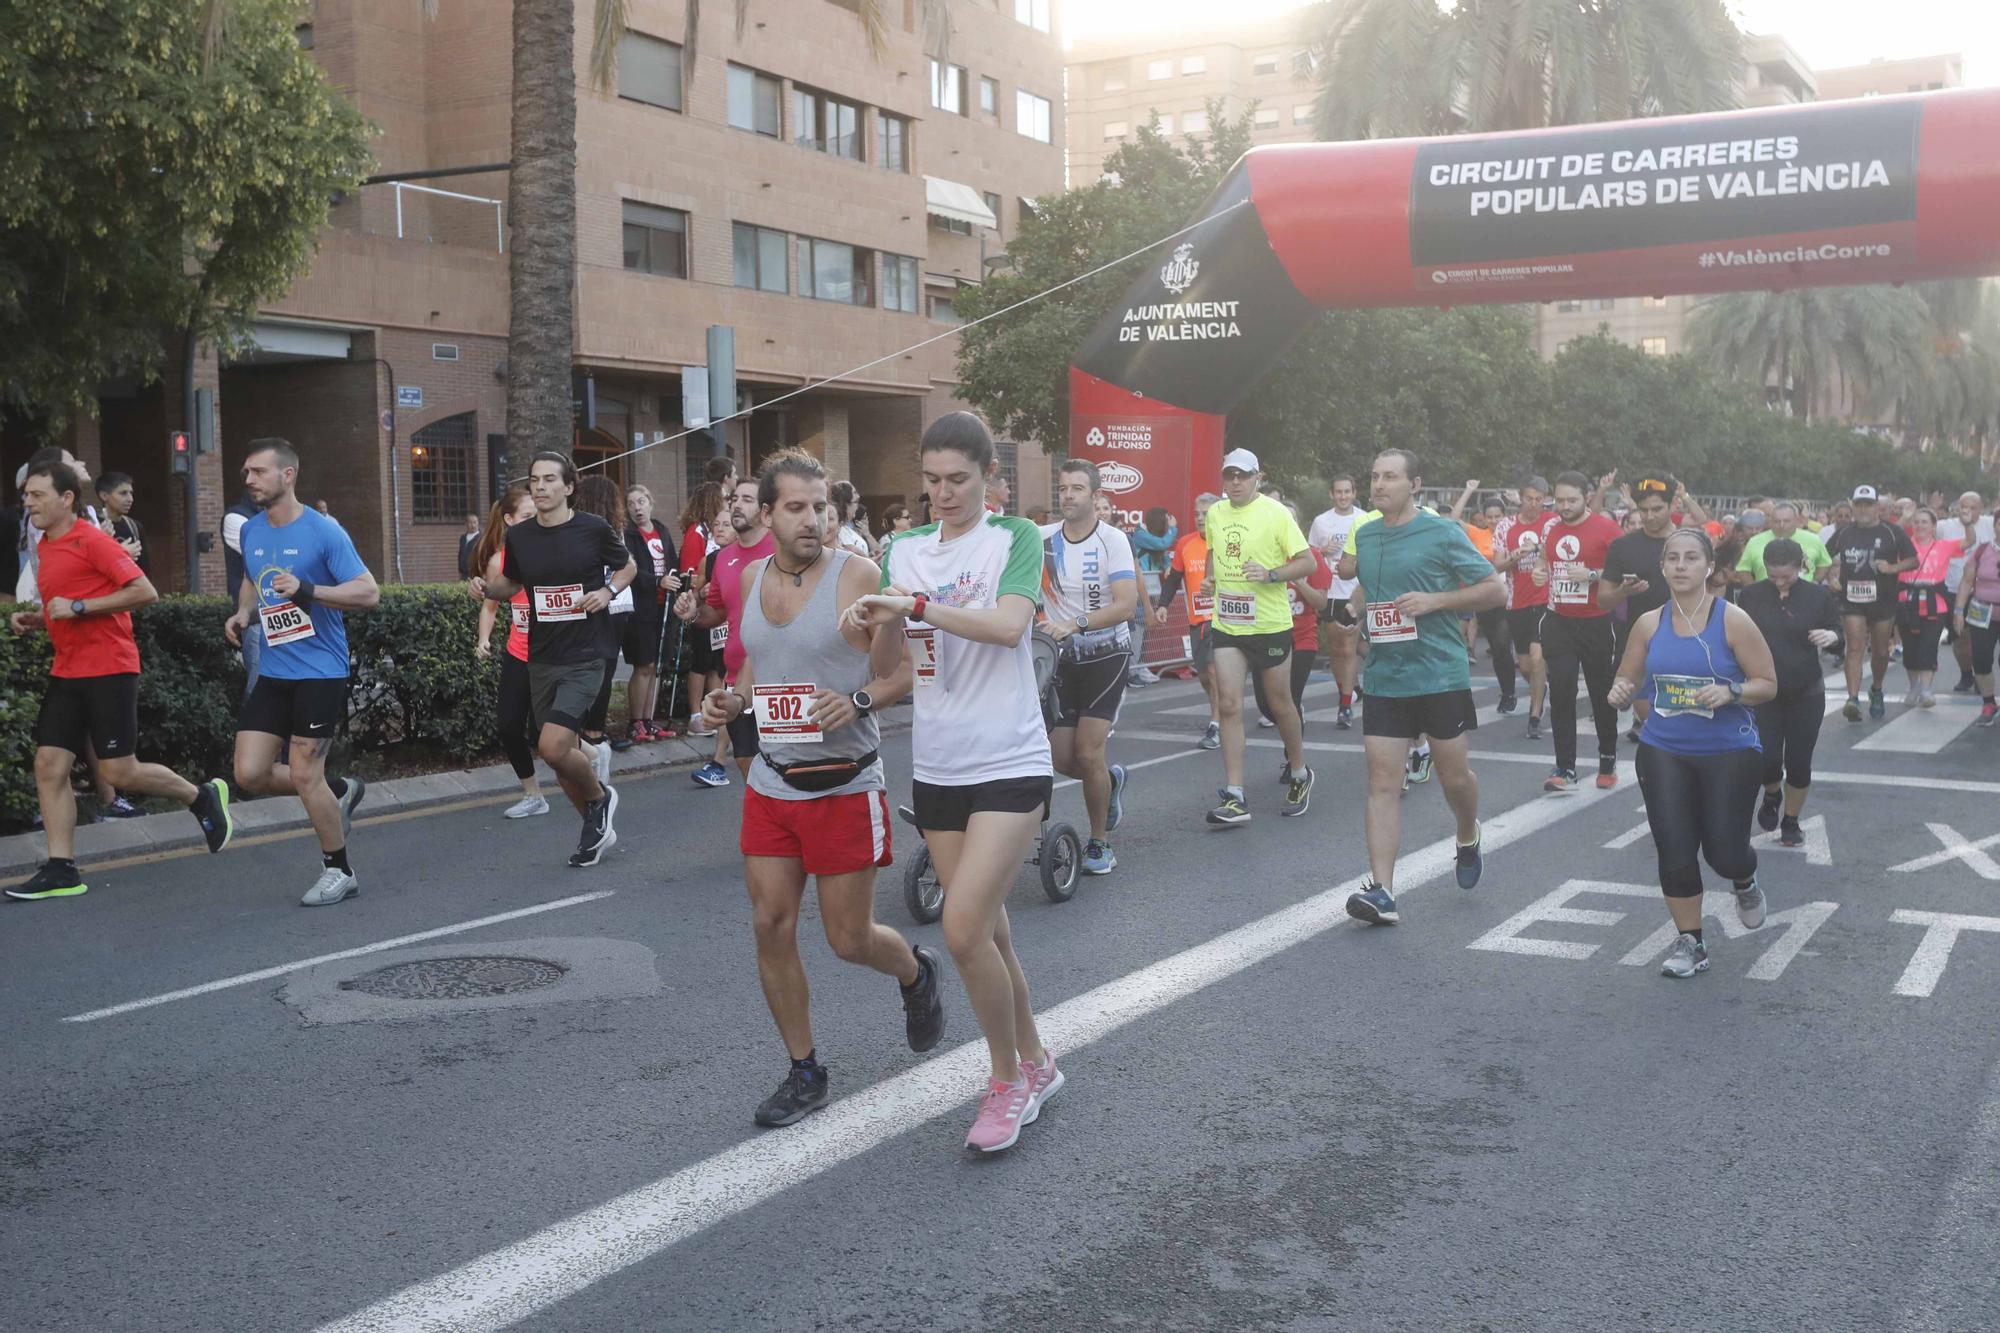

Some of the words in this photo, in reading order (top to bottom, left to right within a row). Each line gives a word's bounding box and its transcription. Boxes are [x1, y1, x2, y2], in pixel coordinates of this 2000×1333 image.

[1429, 155, 1555, 186] CIRCUIT
[1560, 153, 1606, 178] DE
[1610, 136, 1800, 174] CARRERES
[1470, 177, 1648, 216] POPULARS
[1655, 175, 1701, 206] DE
[1706, 158, 1891, 200] VALÈNCIA
[1698, 243, 1891, 268] #ValènciaCorre
[1123, 301, 1240, 323] AJUNTAMENT
[1119, 325, 1141, 342] DE
[1146, 321, 1241, 341] VALÈNCIA
[1107, 424, 1151, 432] FUNDACIÓN
[1107, 431, 1151, 441] TRINIDAD
[1106, 440, 1151, 450] ALFONSO
[1101, 473, 1137, 484] errano
[1082, 548, 1100, 581] TRI
[1559, 582, 1580, 593] 7172
[545, 593, 573, 608] 505
[1221, 600, 1250, 615] 5669
[267, 609, 302, 631] 4985
[1374, 610, 1402, 627] 654
[768, 696, 803, 720] 502
